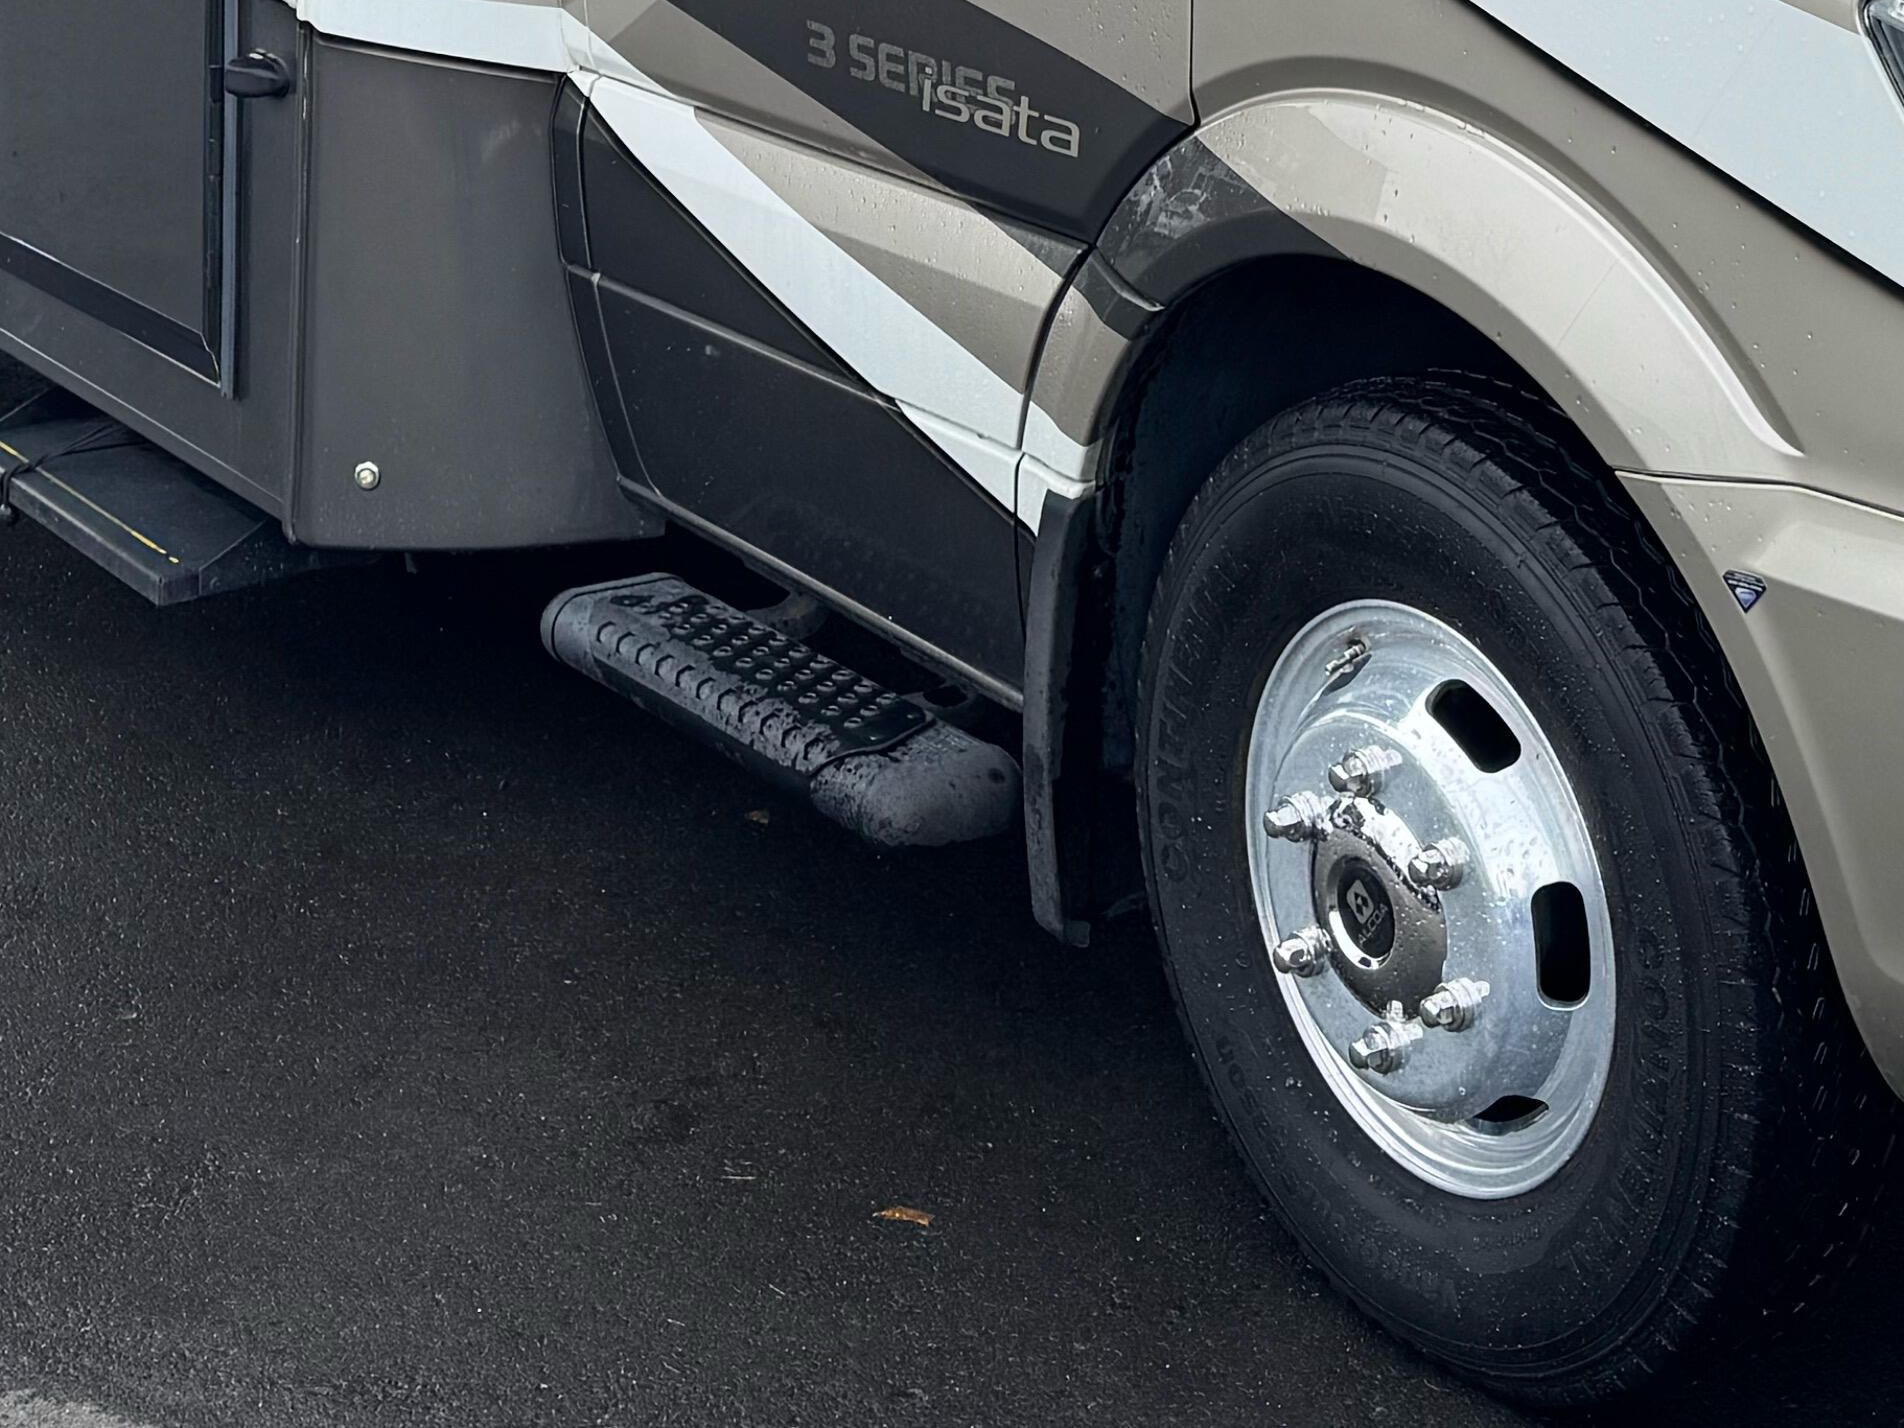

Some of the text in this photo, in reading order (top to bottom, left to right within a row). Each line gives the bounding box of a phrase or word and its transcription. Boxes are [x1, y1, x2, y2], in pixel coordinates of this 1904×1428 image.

[807, 20, 1016, 126] 3 SERIES
[921, 67, 1080, 158] isata
[1358, 904, 1388, 948] ALCOA
